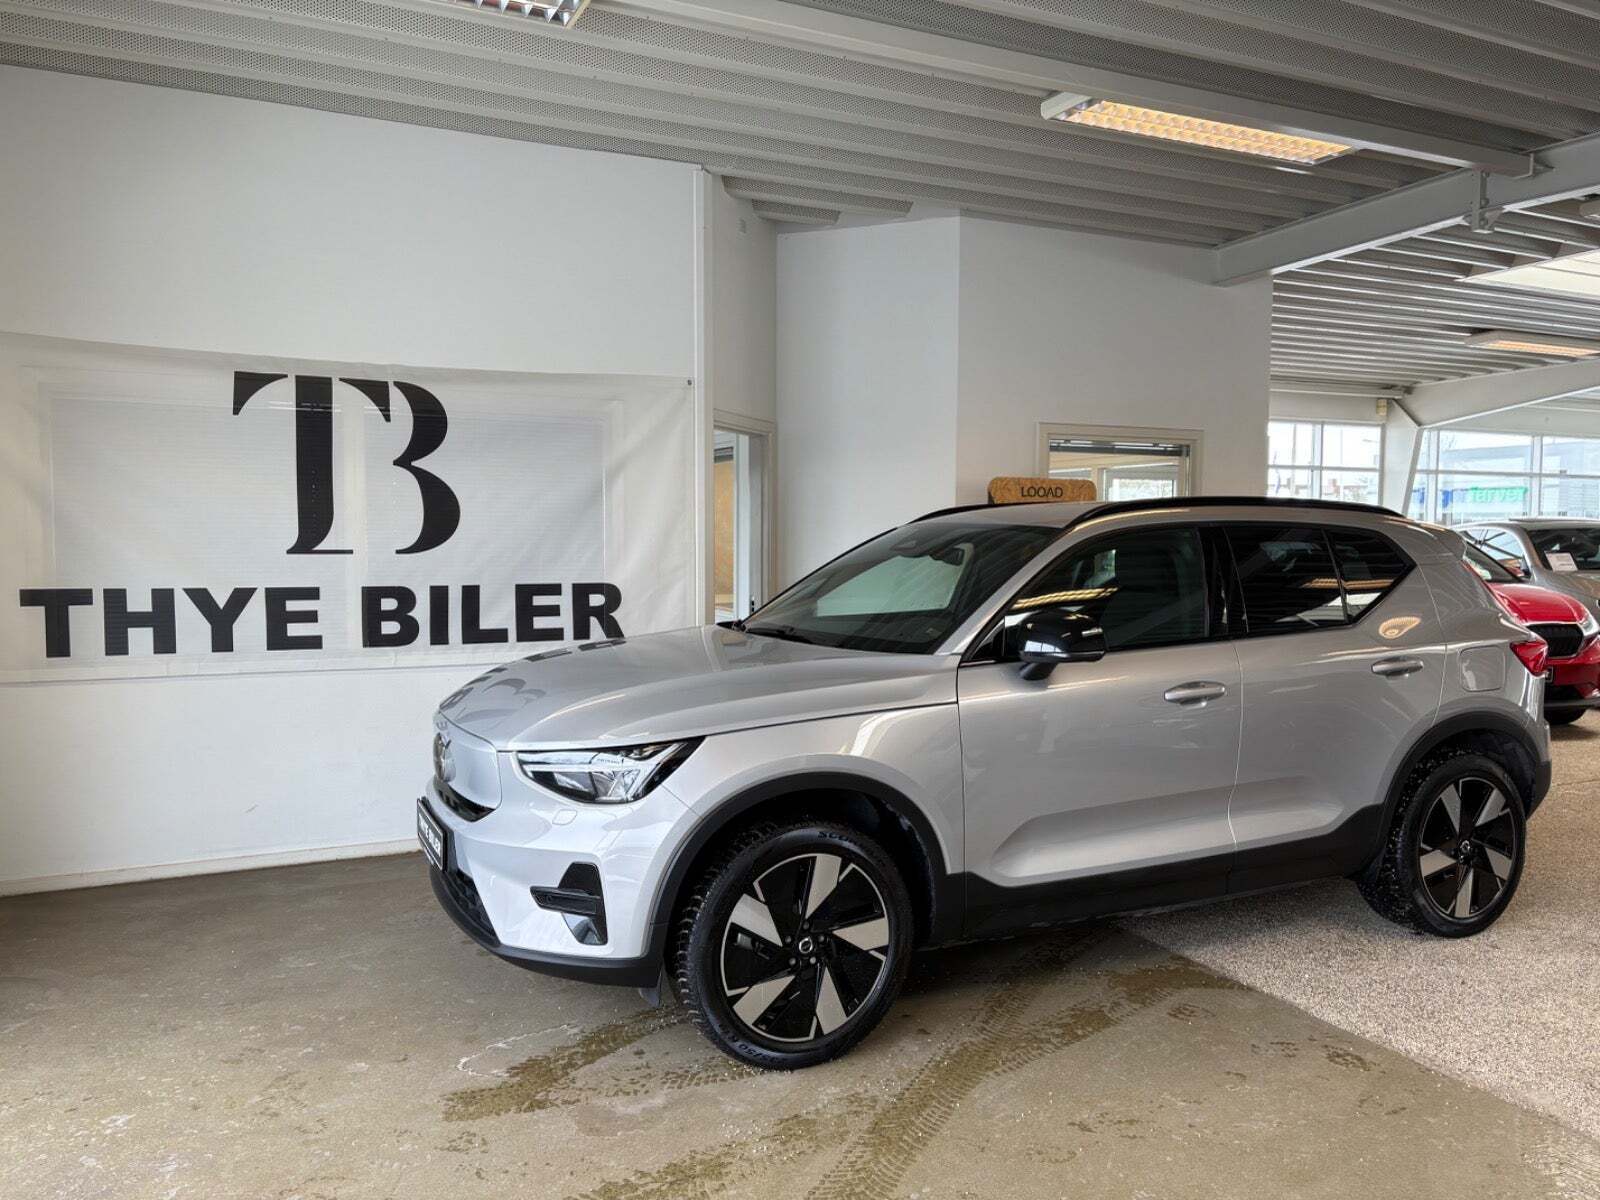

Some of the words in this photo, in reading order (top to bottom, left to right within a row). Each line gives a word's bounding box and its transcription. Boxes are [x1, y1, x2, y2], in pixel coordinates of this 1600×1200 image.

[233, 371, 461, 555] TB
[1020, 486, 1064, 498] LOOAD
[20, 587, 323, 658] THYE
[362, 583, 625, 648] BILER
